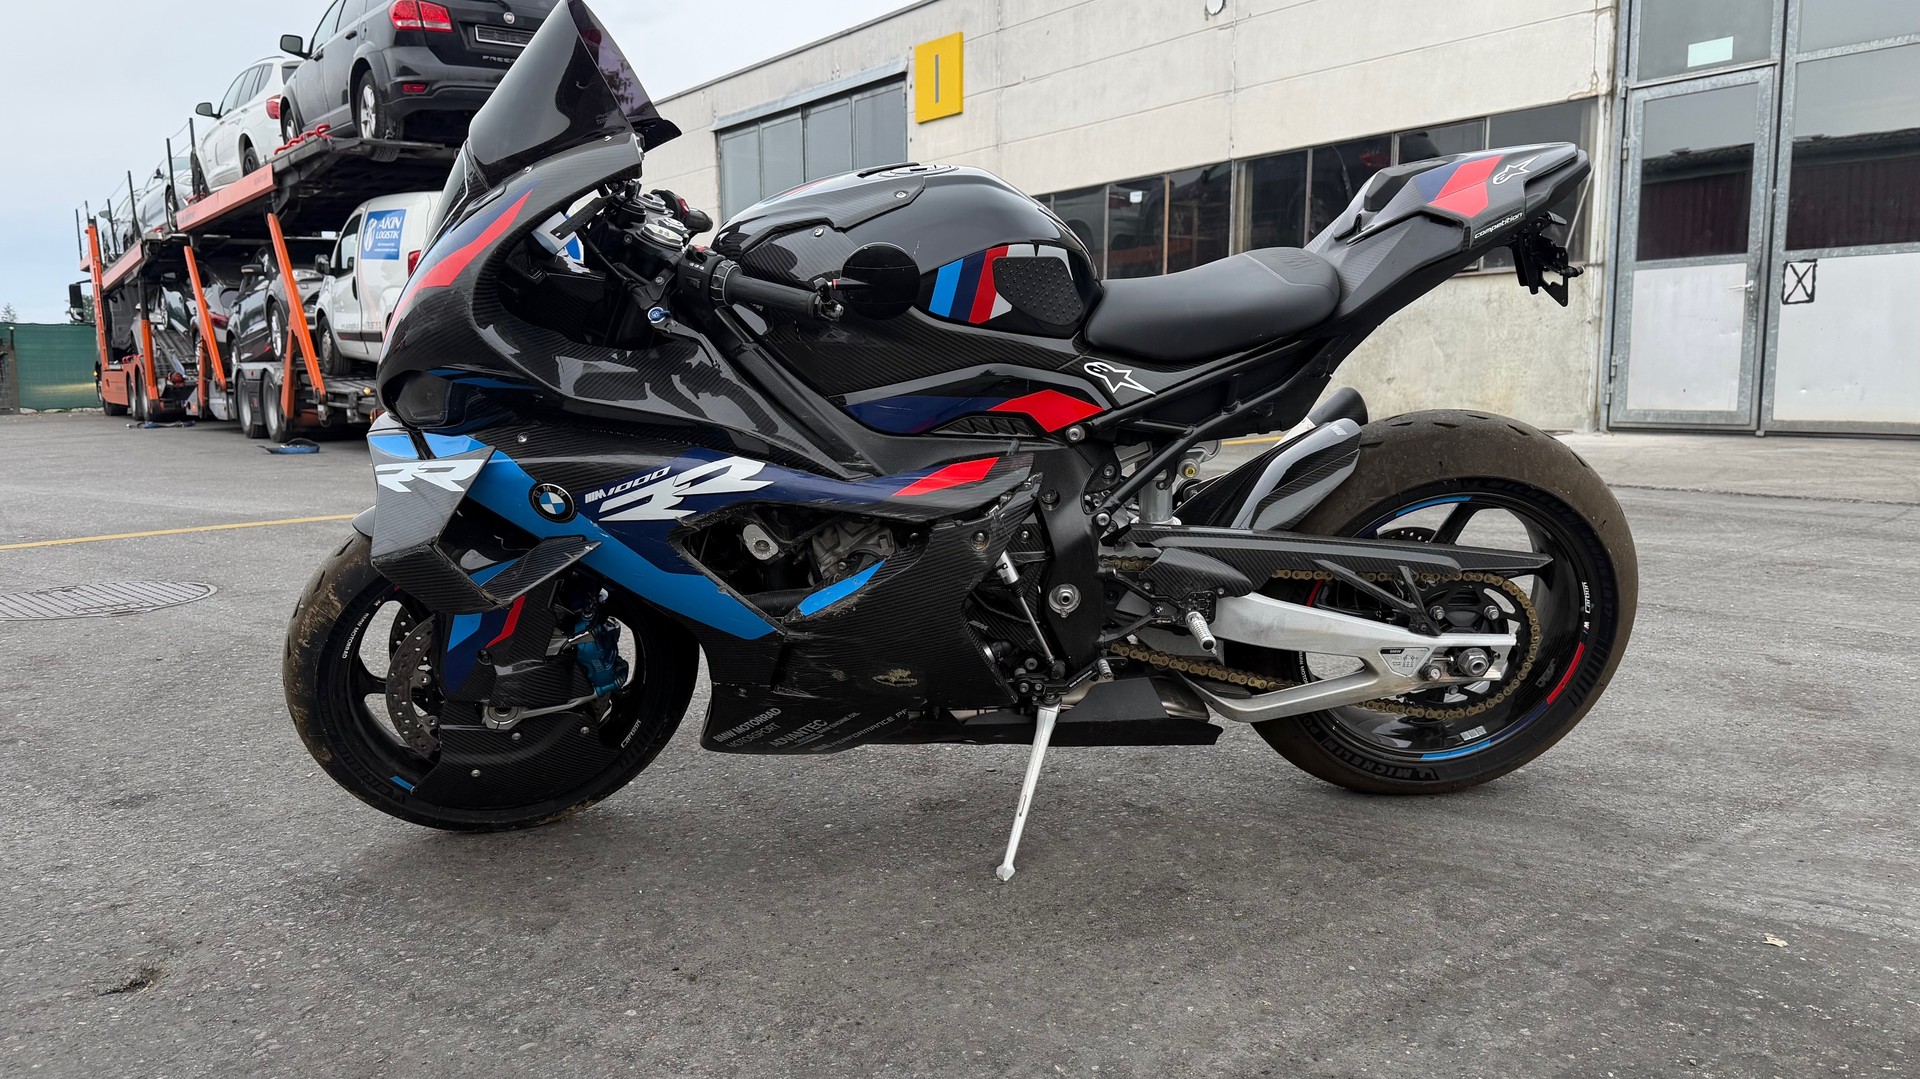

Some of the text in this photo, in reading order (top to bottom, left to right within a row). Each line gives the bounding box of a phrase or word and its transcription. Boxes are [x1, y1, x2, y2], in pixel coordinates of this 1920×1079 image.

[375, 230, 401, 240] LOGISTIK
[377, 216, 404, 230] AKIN
[1474, 212, 1523, 239] competition
[375, 459, 485, 493] RR
[598, 455, 775, 522] RR
[605, 465, 672, 497] 1000
[533, 485, 566, 499] BMW
[341, 626, 360, 659] MOTORRAD
[713, 707, 782, 743] BMW MOTORRAD
[726, 722, 781, 749] MOTORSPORT
[769, 719, 828, 747] ADVANTEC
[830, 716, 896, 747] PERFORMANCE
[1302, 715, 1414, 779] MICHELIN PO
